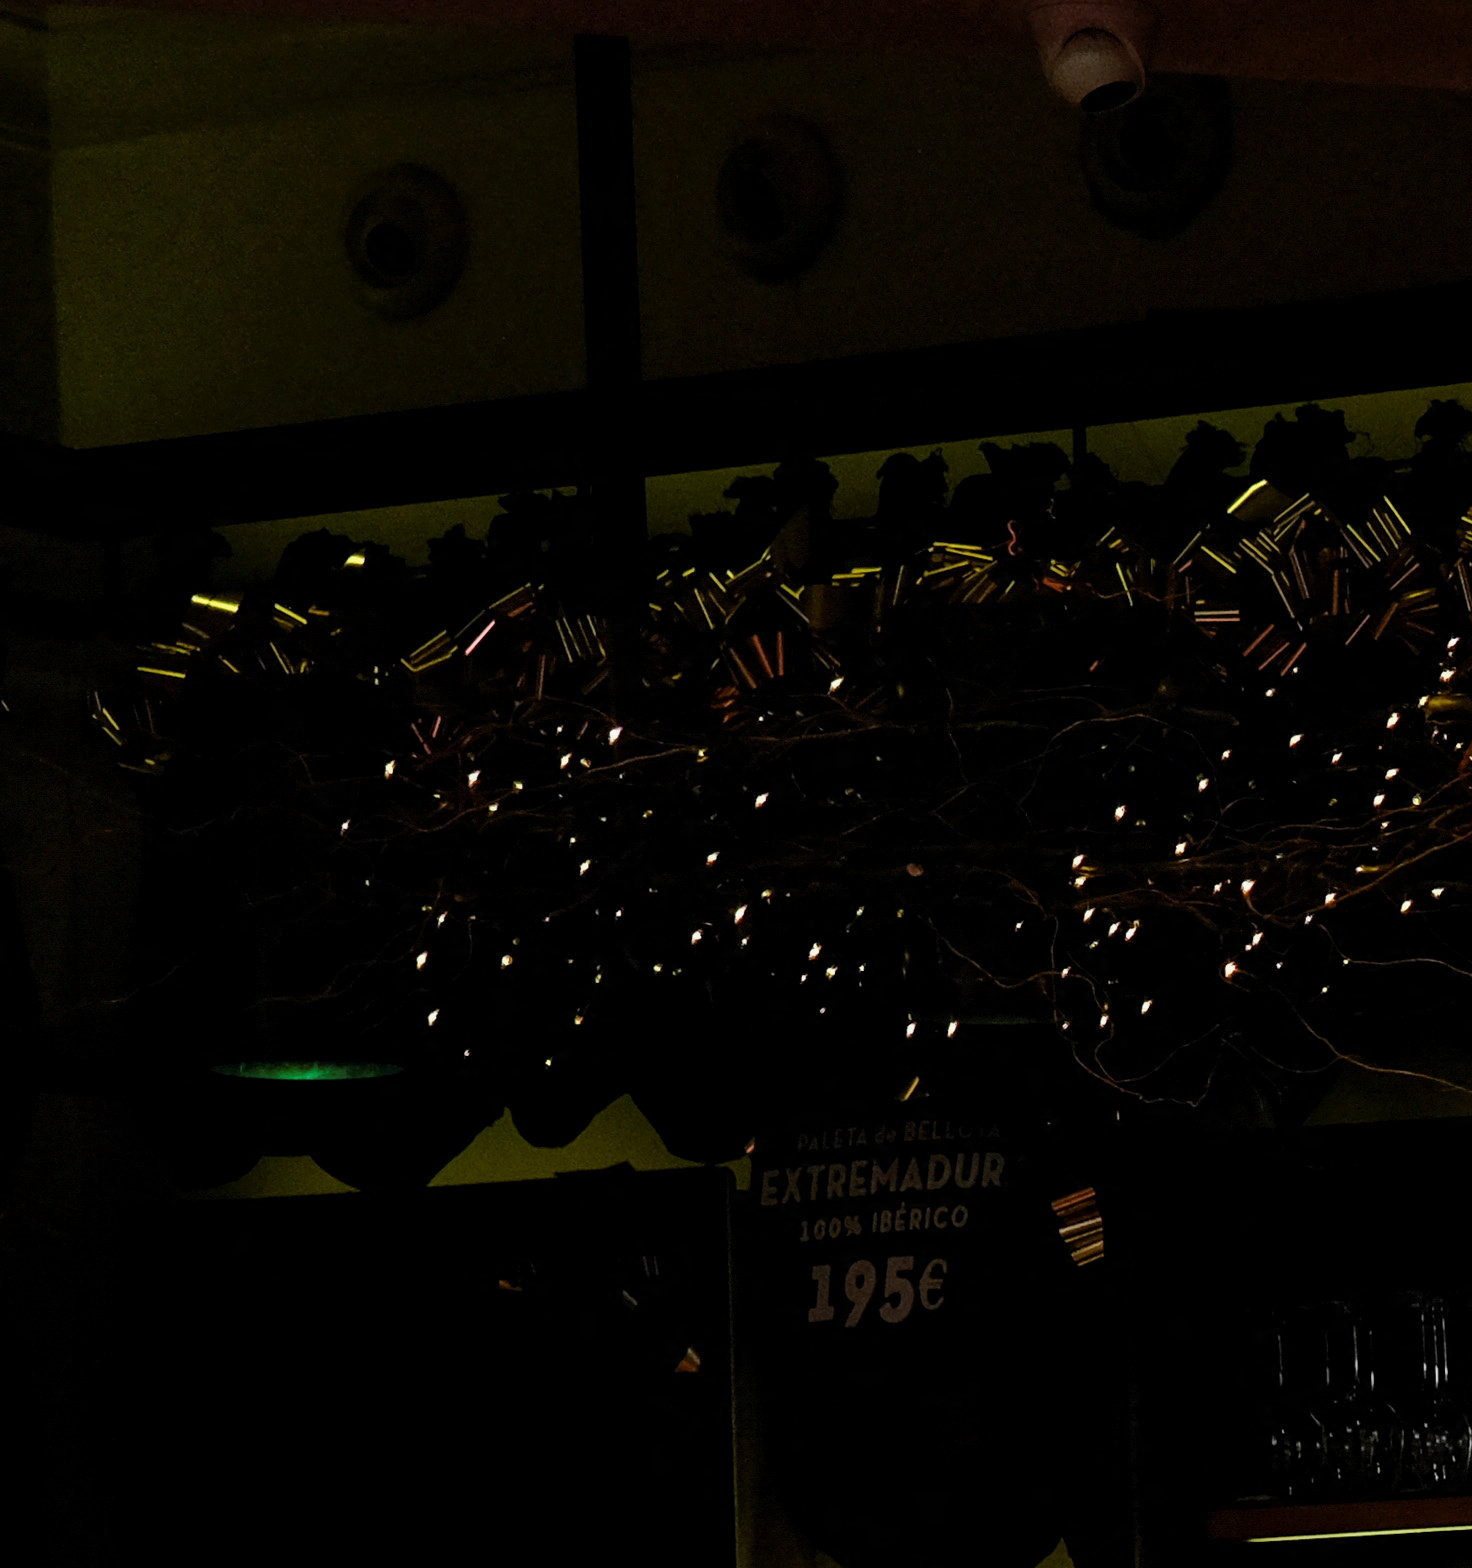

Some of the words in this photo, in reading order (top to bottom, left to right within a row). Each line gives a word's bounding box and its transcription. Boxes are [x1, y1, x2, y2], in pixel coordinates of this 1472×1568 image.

[796, 1126, 869, 1153] PALETA
[760, 1152, 1006, 1207] EXTREMADUR
[800, 1219, 863, 1242] 100%
[872, 1202, 970, 1234] IBÉRICO
[808, 1256, 949, 1328] 195€
